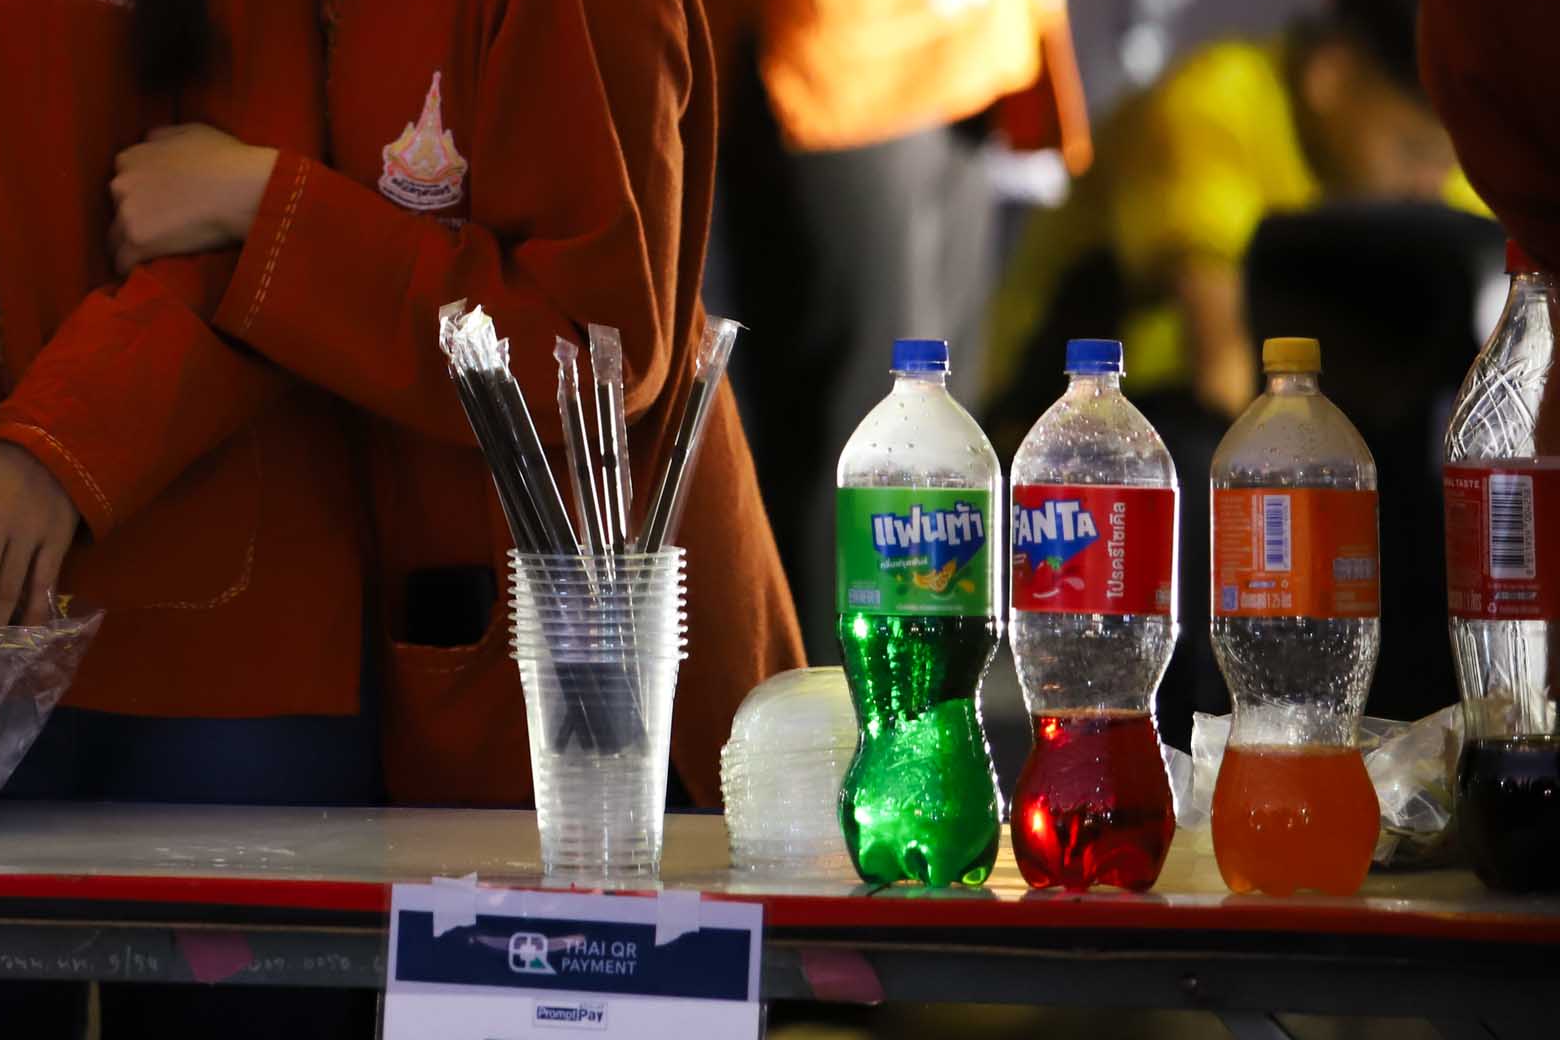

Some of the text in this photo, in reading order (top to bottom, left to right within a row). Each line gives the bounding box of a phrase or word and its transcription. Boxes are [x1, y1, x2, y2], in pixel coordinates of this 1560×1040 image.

[873, 503, 984, 548] แฟนต้า
[1013, 501, 1097, 546] FANTA
[1106, 502, 1127, 599] โปรดรีไซเคิล
[564, 939, 638, 959] THAI QR
[561, 958, 637, 975] PAYMENT
[536, 1005, 604, 1023] PromptPay
